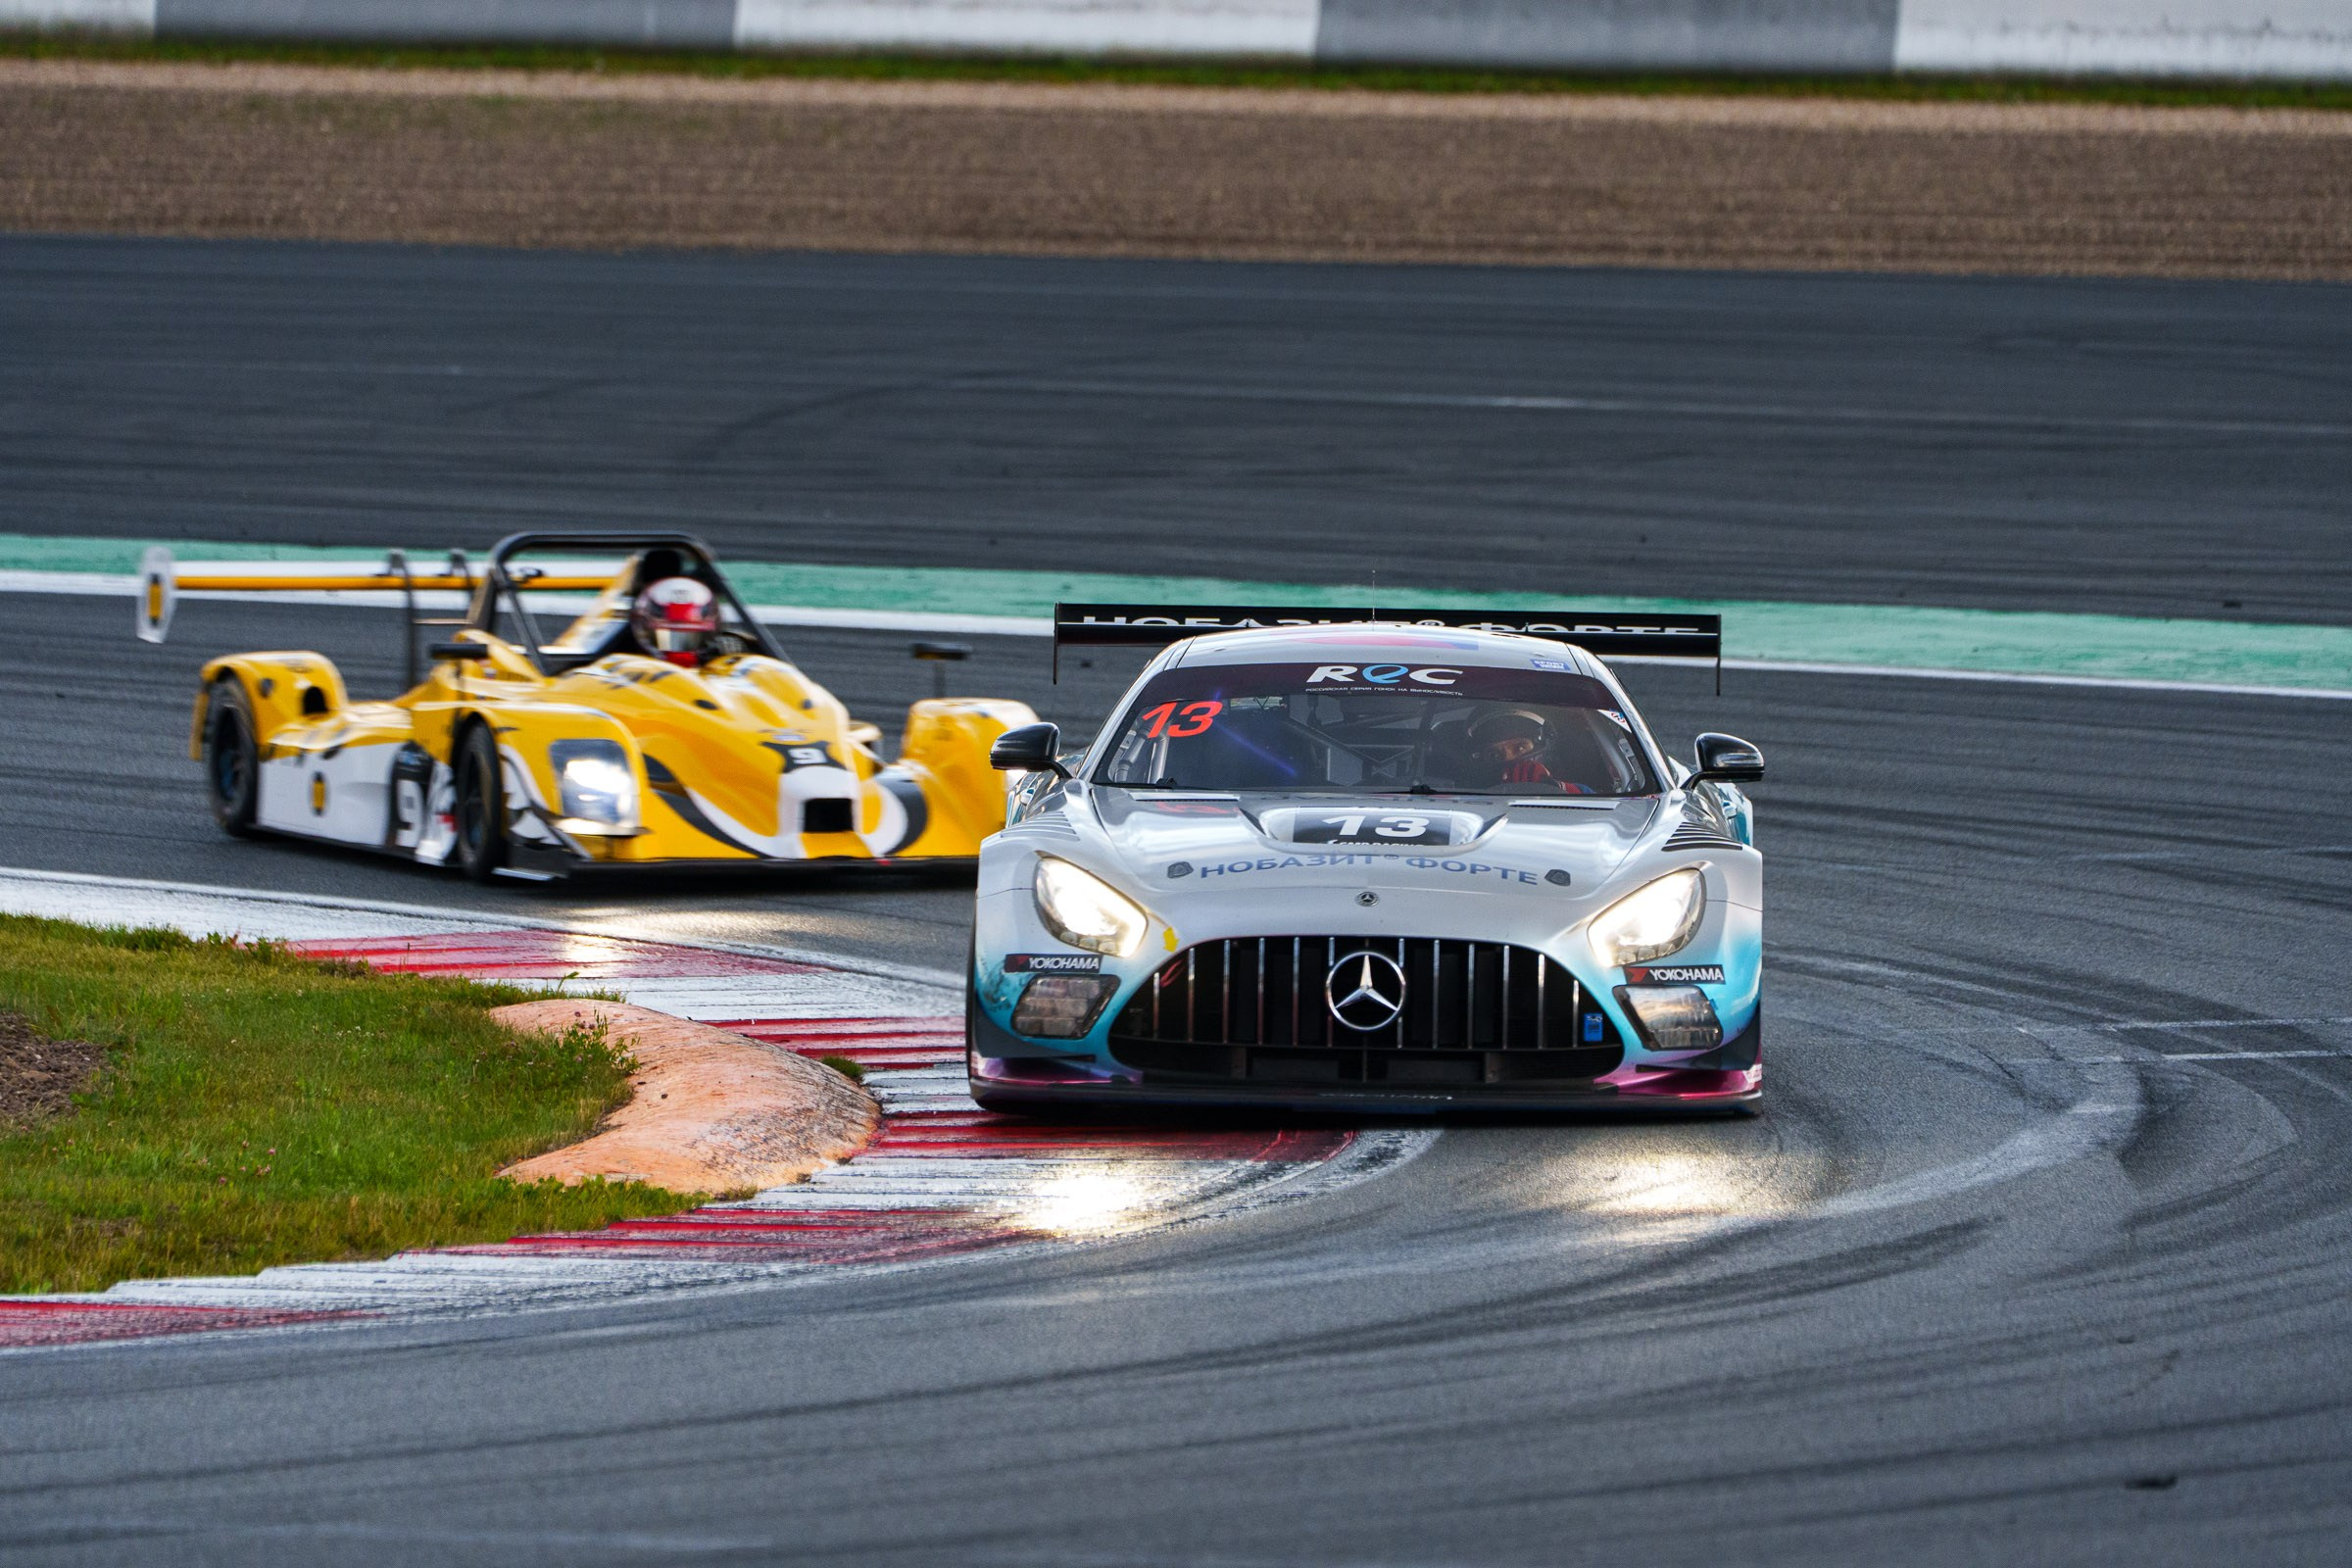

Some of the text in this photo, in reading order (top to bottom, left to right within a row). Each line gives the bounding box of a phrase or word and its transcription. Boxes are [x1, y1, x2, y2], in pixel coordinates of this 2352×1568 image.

[1142, 701, 1223, 739] 13
[788, 748, 827, 764] 9
[396, 779, 424, 848] 9
[1323, 815, 1430, 838] 13
[1405, 858, 1538, 885] ФОРТЕ
[1029, 957, 1100, 969] YOKOHAMA
[1649, 967, 1724, 981] YOKOHAMA
